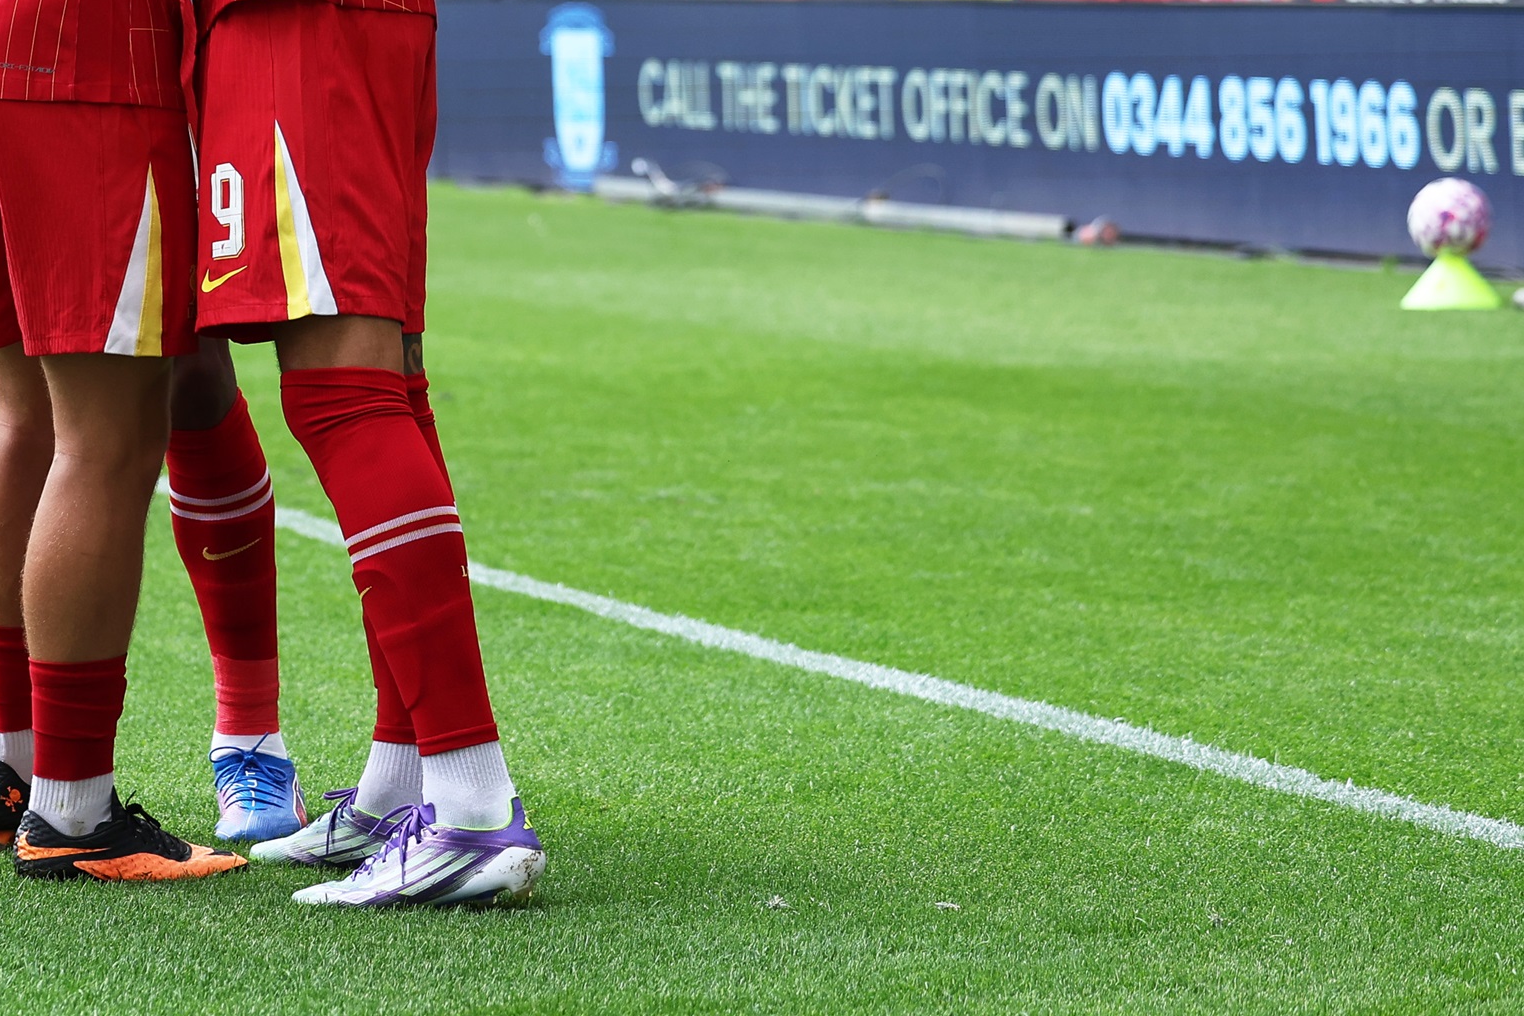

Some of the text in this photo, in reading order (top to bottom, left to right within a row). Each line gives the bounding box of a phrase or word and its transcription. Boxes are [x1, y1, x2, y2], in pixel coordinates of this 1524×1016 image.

[638, 57, 716, 131] CALL
[716, 61, 780, 135] THE
[781, 63, 897, 141] TICKET
[902, 67, 1031, 148] OFFICE
[1035, 72, 1100, 153] ON
[1102, 70, 1216, 160] 0344
[1219, 73, 1308, 164] 856
[1310, 77, 1421, 170] 1966
[1426, 86, 1499, 175] OR
[210, 162, 245, 261] 9
